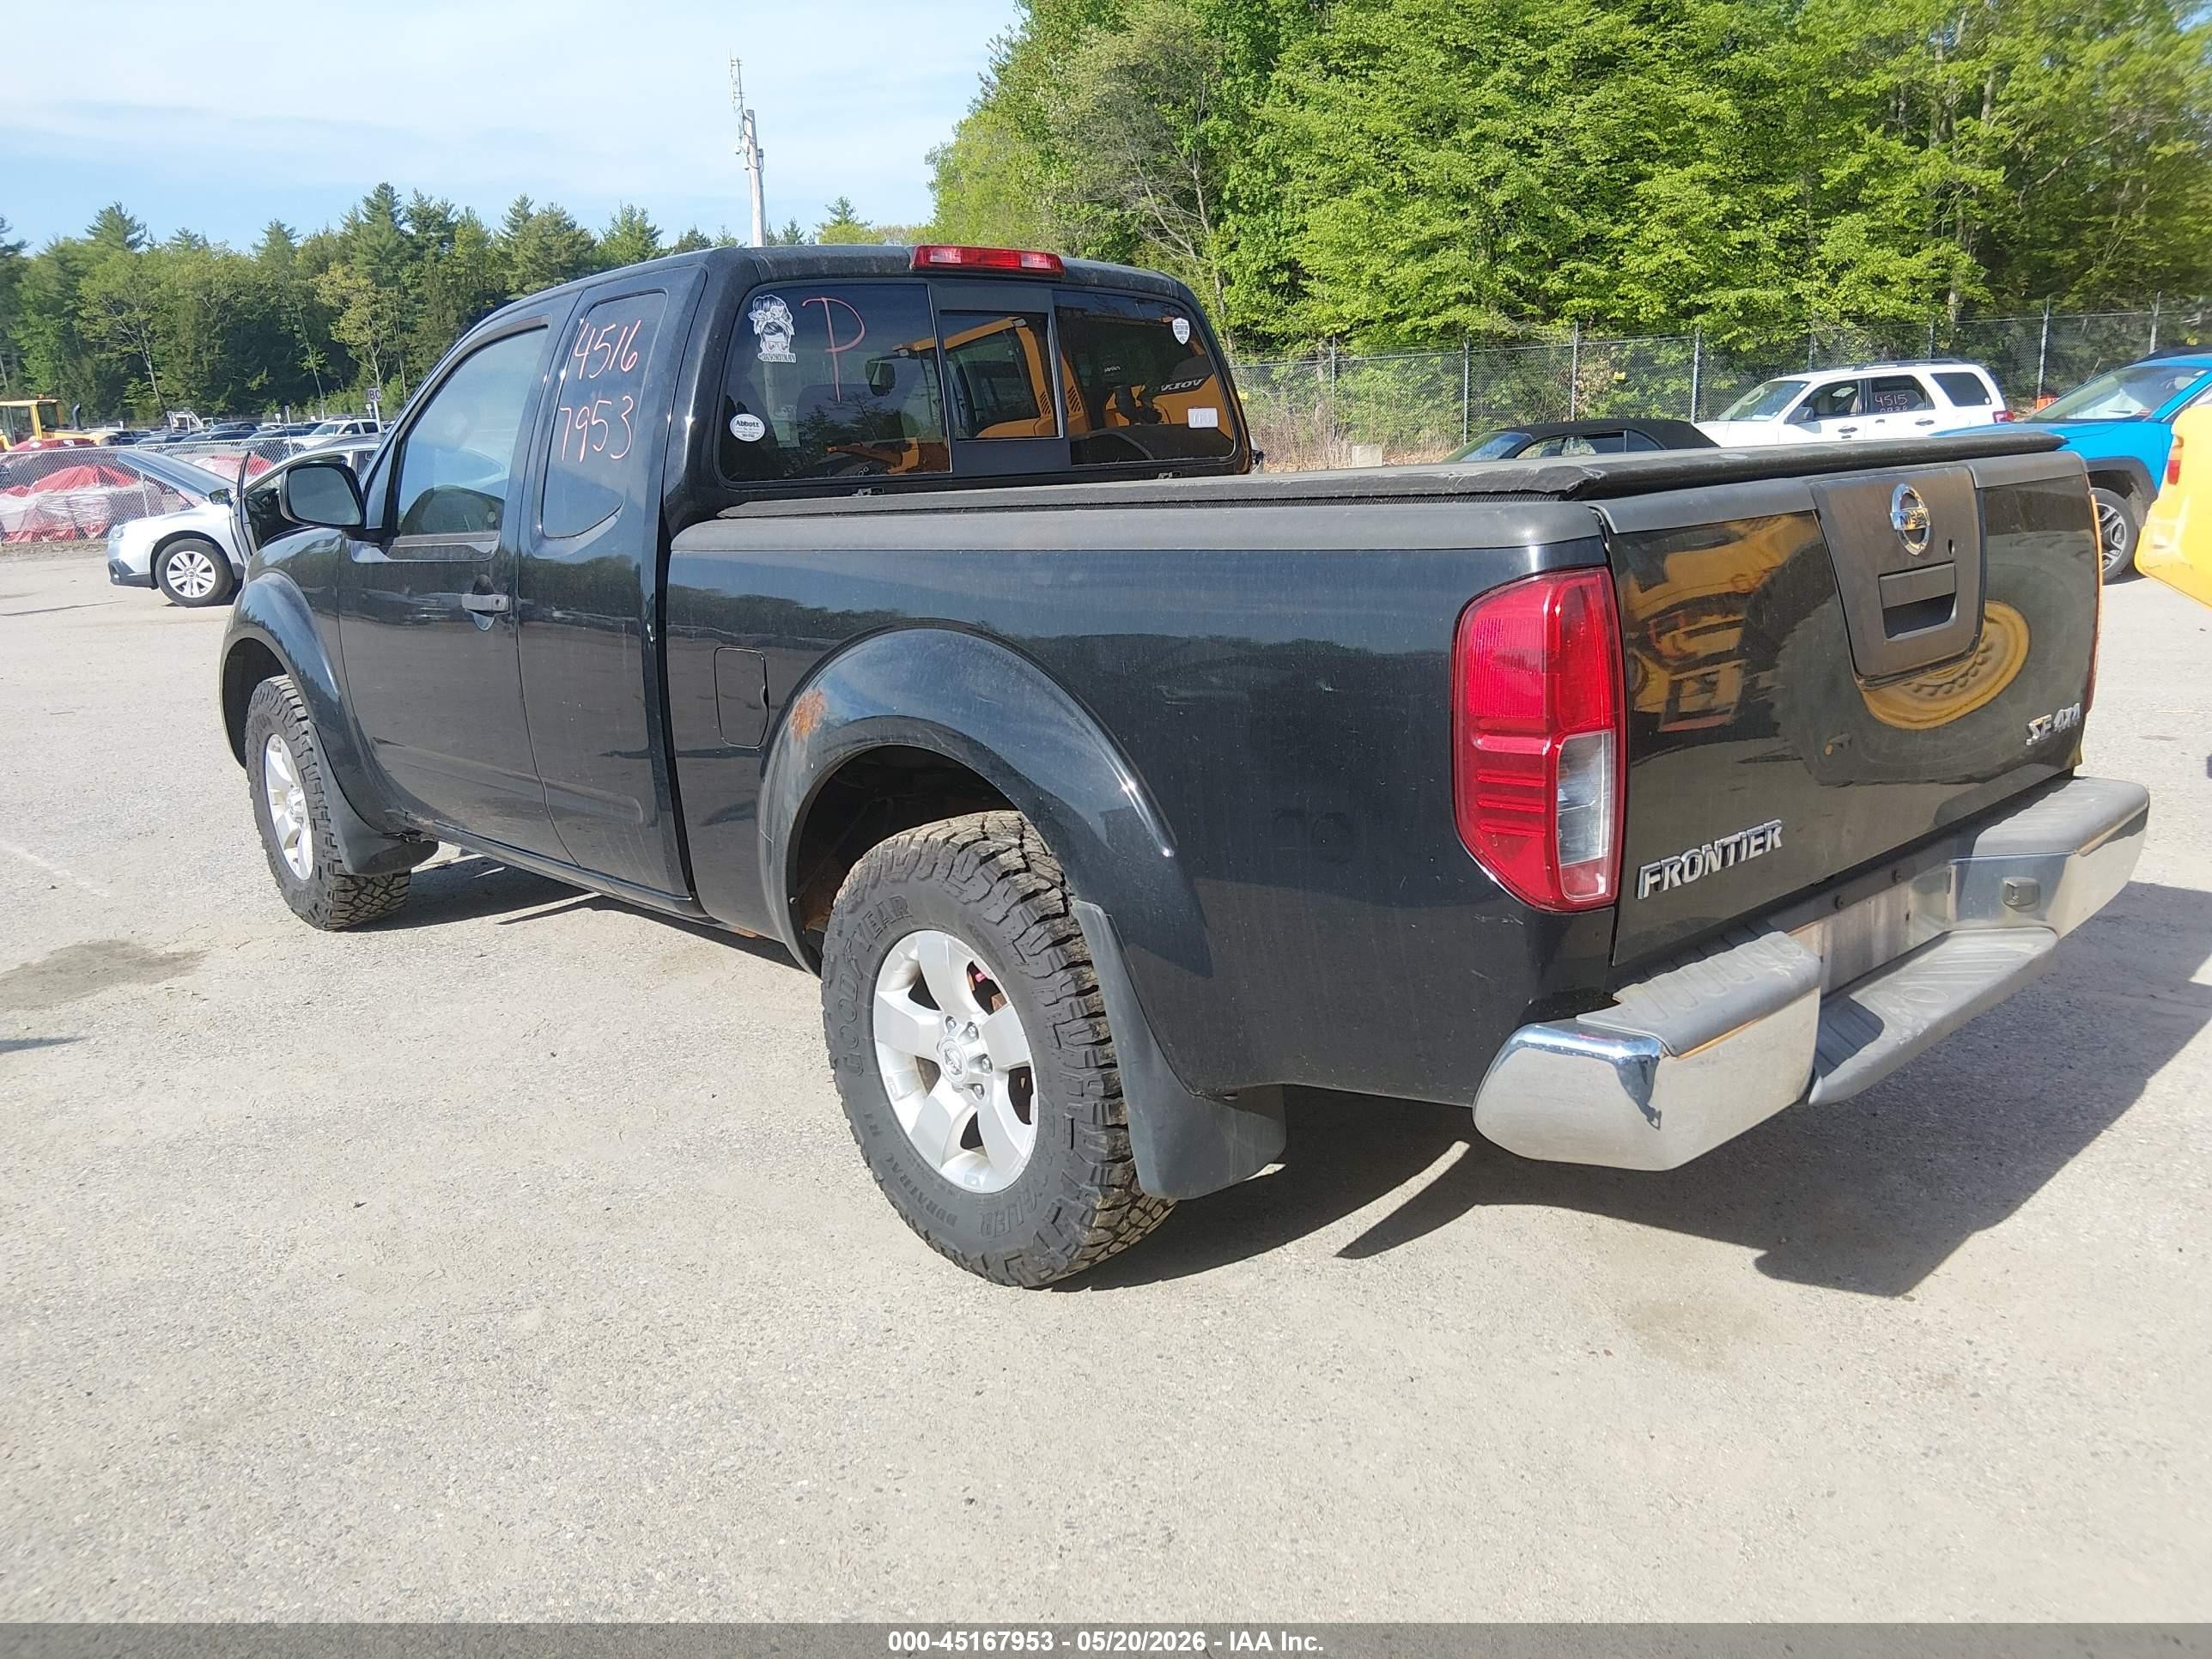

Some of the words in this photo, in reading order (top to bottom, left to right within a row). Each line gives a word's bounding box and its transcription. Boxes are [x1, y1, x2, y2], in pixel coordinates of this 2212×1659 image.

[574, 319, 641, 380] 4516
[801, 297, 866, 404] P
[369, 390, 381, 399] BC
[1875, 393, 1908, 406] 4515
[559, 396, 634, 462] 7953
[1637, 819, 1783, 899] FRONTIER
